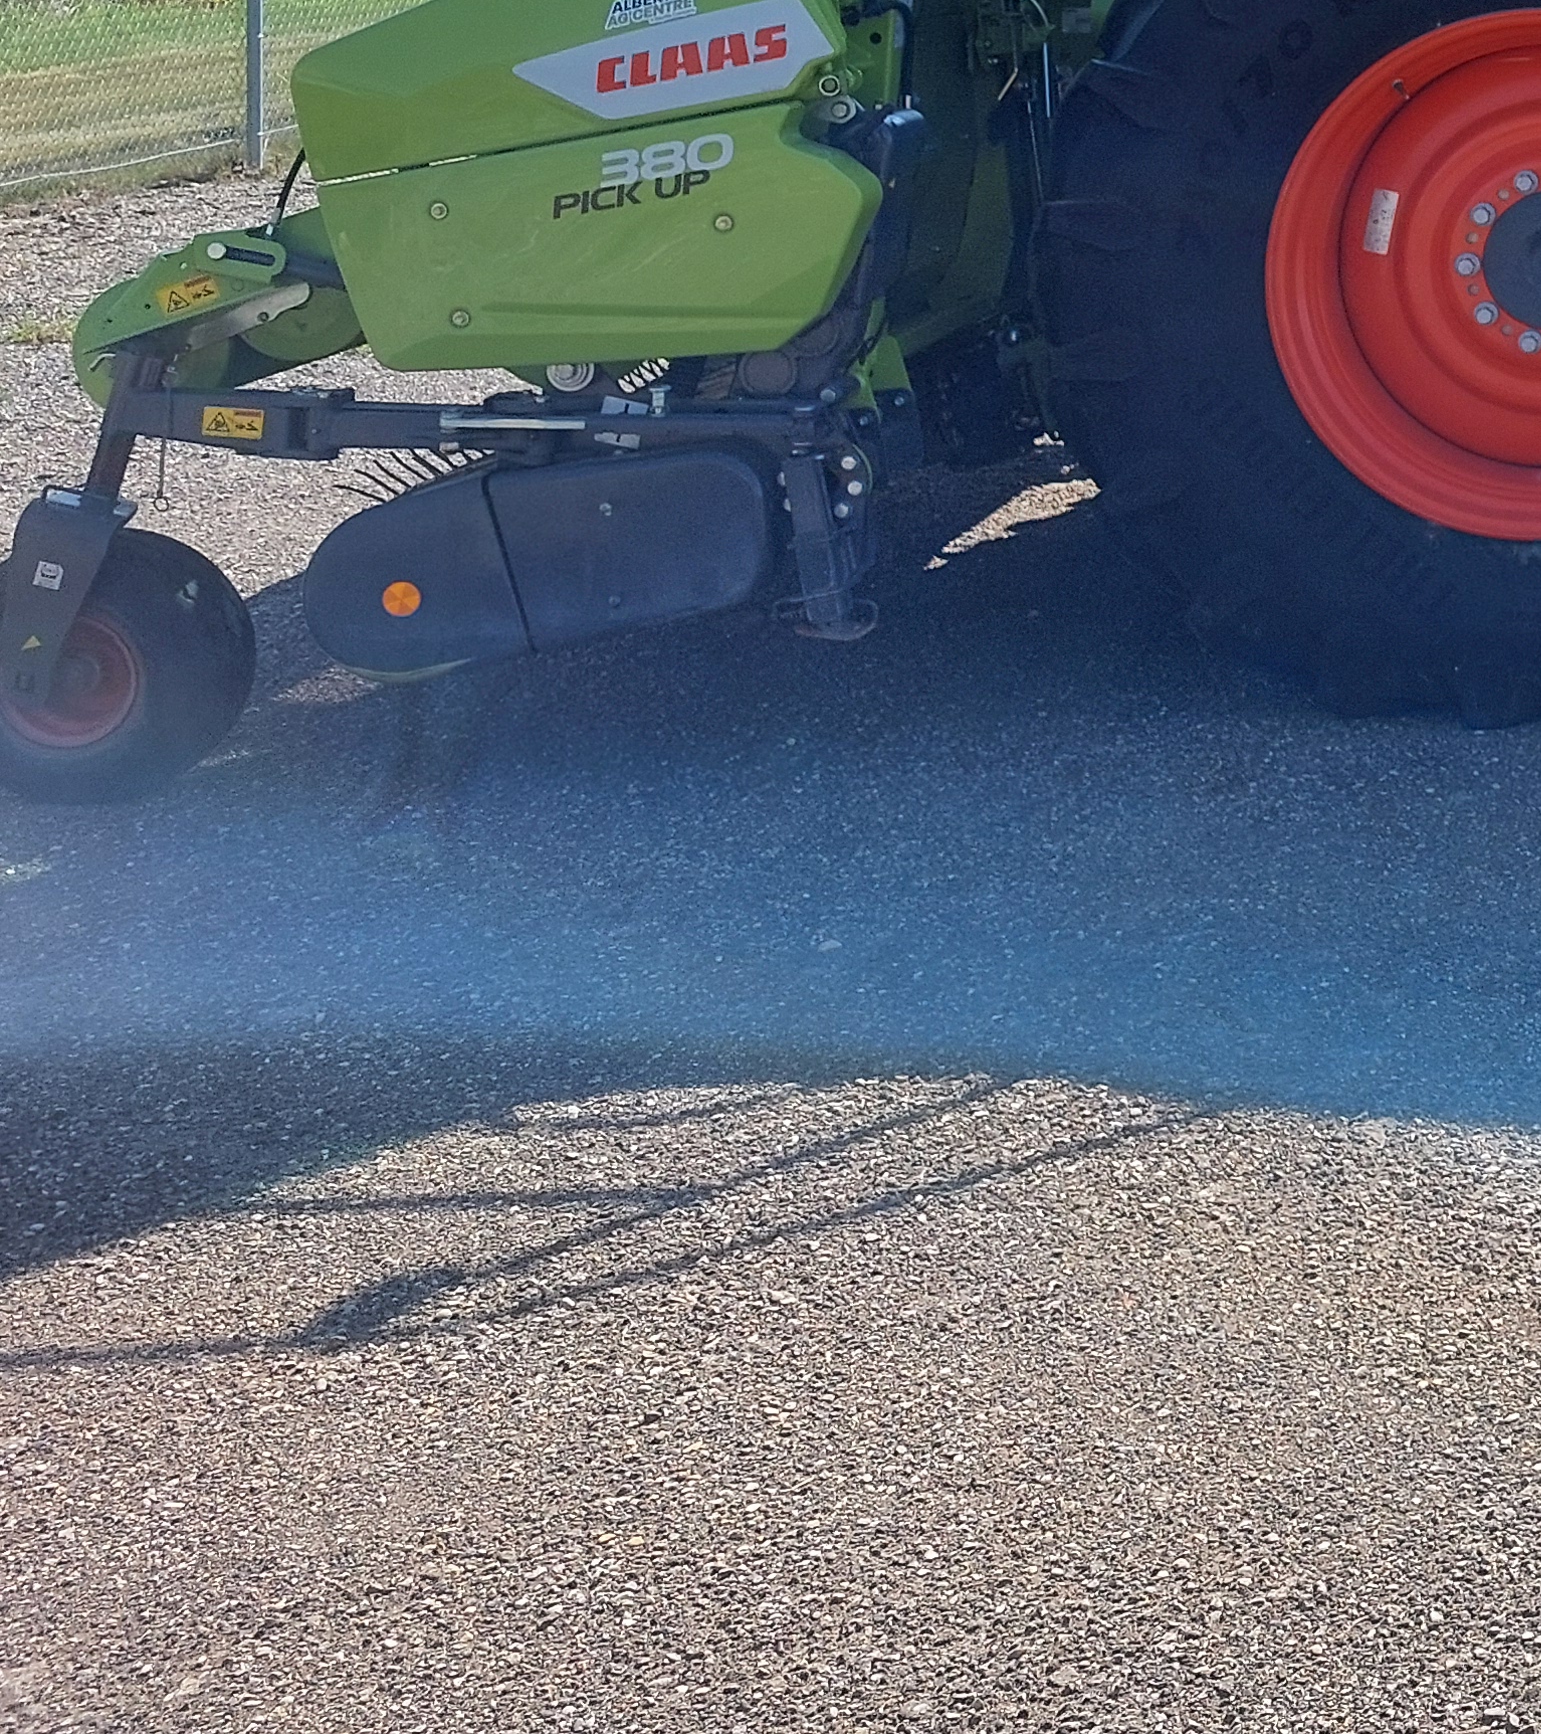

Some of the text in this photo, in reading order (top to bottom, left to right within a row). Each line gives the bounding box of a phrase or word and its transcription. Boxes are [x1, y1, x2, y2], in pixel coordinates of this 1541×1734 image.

[607, 12, 629, 27] AG
[596, 24, 788, 94] CLAAS
[601, 132, 734, 188] 380
[553, 169, 711, 220] PICK UP
